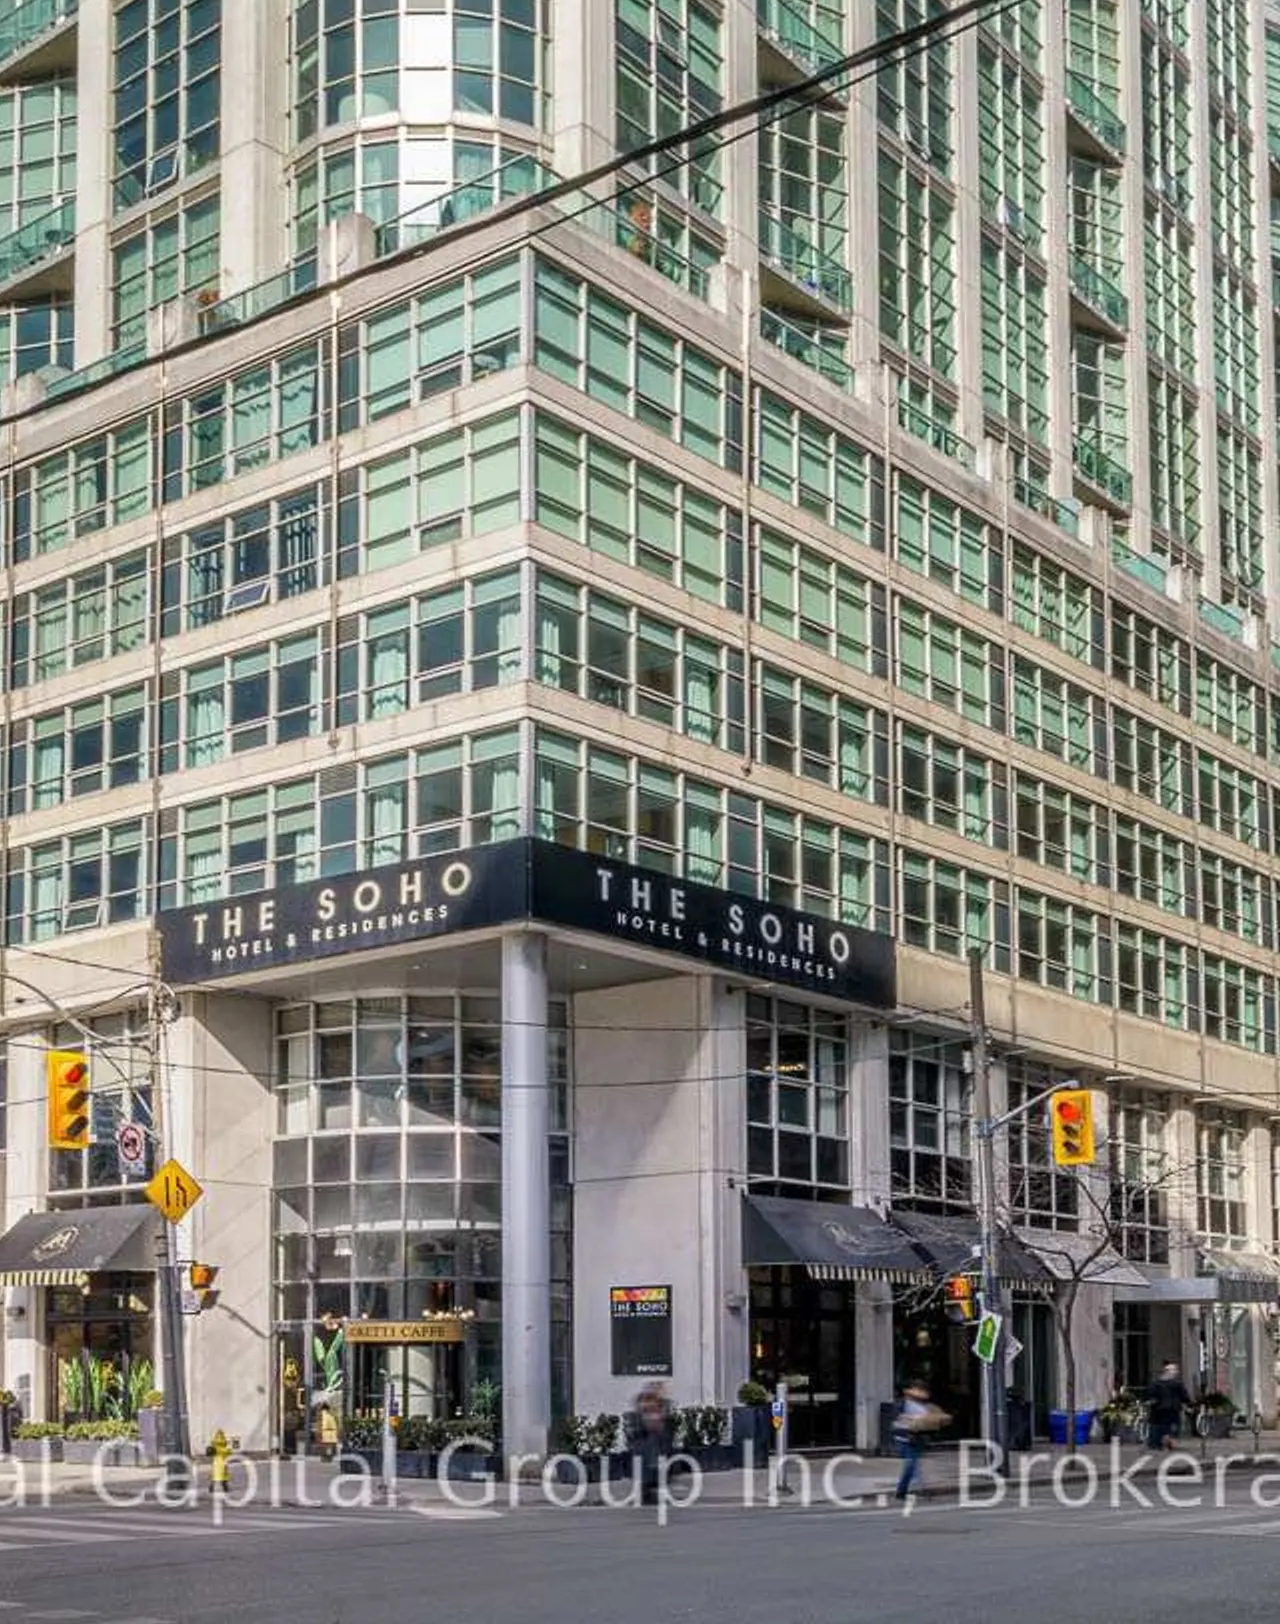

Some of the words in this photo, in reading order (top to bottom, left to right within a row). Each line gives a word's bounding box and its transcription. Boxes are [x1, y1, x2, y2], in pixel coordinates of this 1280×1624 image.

[193, 900, 275, 945] THE
[318, 862, 471, 920] SOHO
[212, 942, 273, 962] HOTEL
[312, 904, 448, 942] RESIDENCES
[597, 868, 685, 920] THE
[728, 905, 850, 963] SOHO
[617, 912, 683, 940] HOTEL
[722, 939, 835, 979] RESIDENCES
